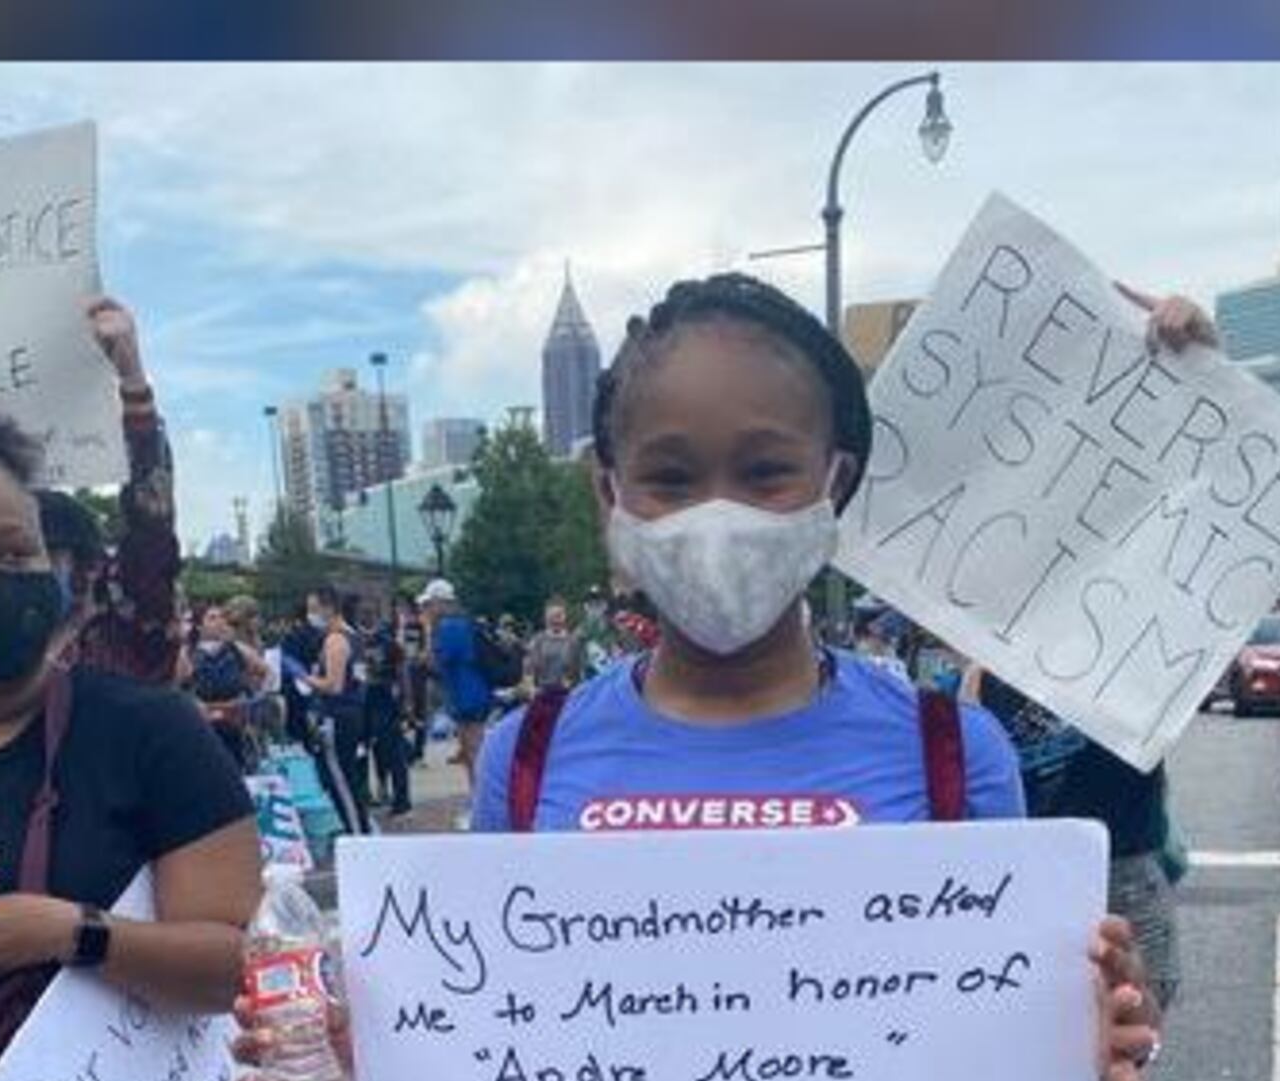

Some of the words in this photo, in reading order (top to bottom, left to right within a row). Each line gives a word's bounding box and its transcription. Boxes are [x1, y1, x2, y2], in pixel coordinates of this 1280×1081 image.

[902, 328, 1273, 631] SYSTEMIC
[578, 797, 813, 831] CONVERSE
[360, 884, 487, 994] My
[501, 885, 825, 953] Grandmother
[863, 872, 1012, 923] asked
[393, 1003, 455, 1034] Me
[493, 992, 536, 1026] to
[560, 981, 698, 1028] March
[712, 981, 751, 1011] in
[787, 966, 938, 1001] honor
[955, 952, 1031, 992] of
